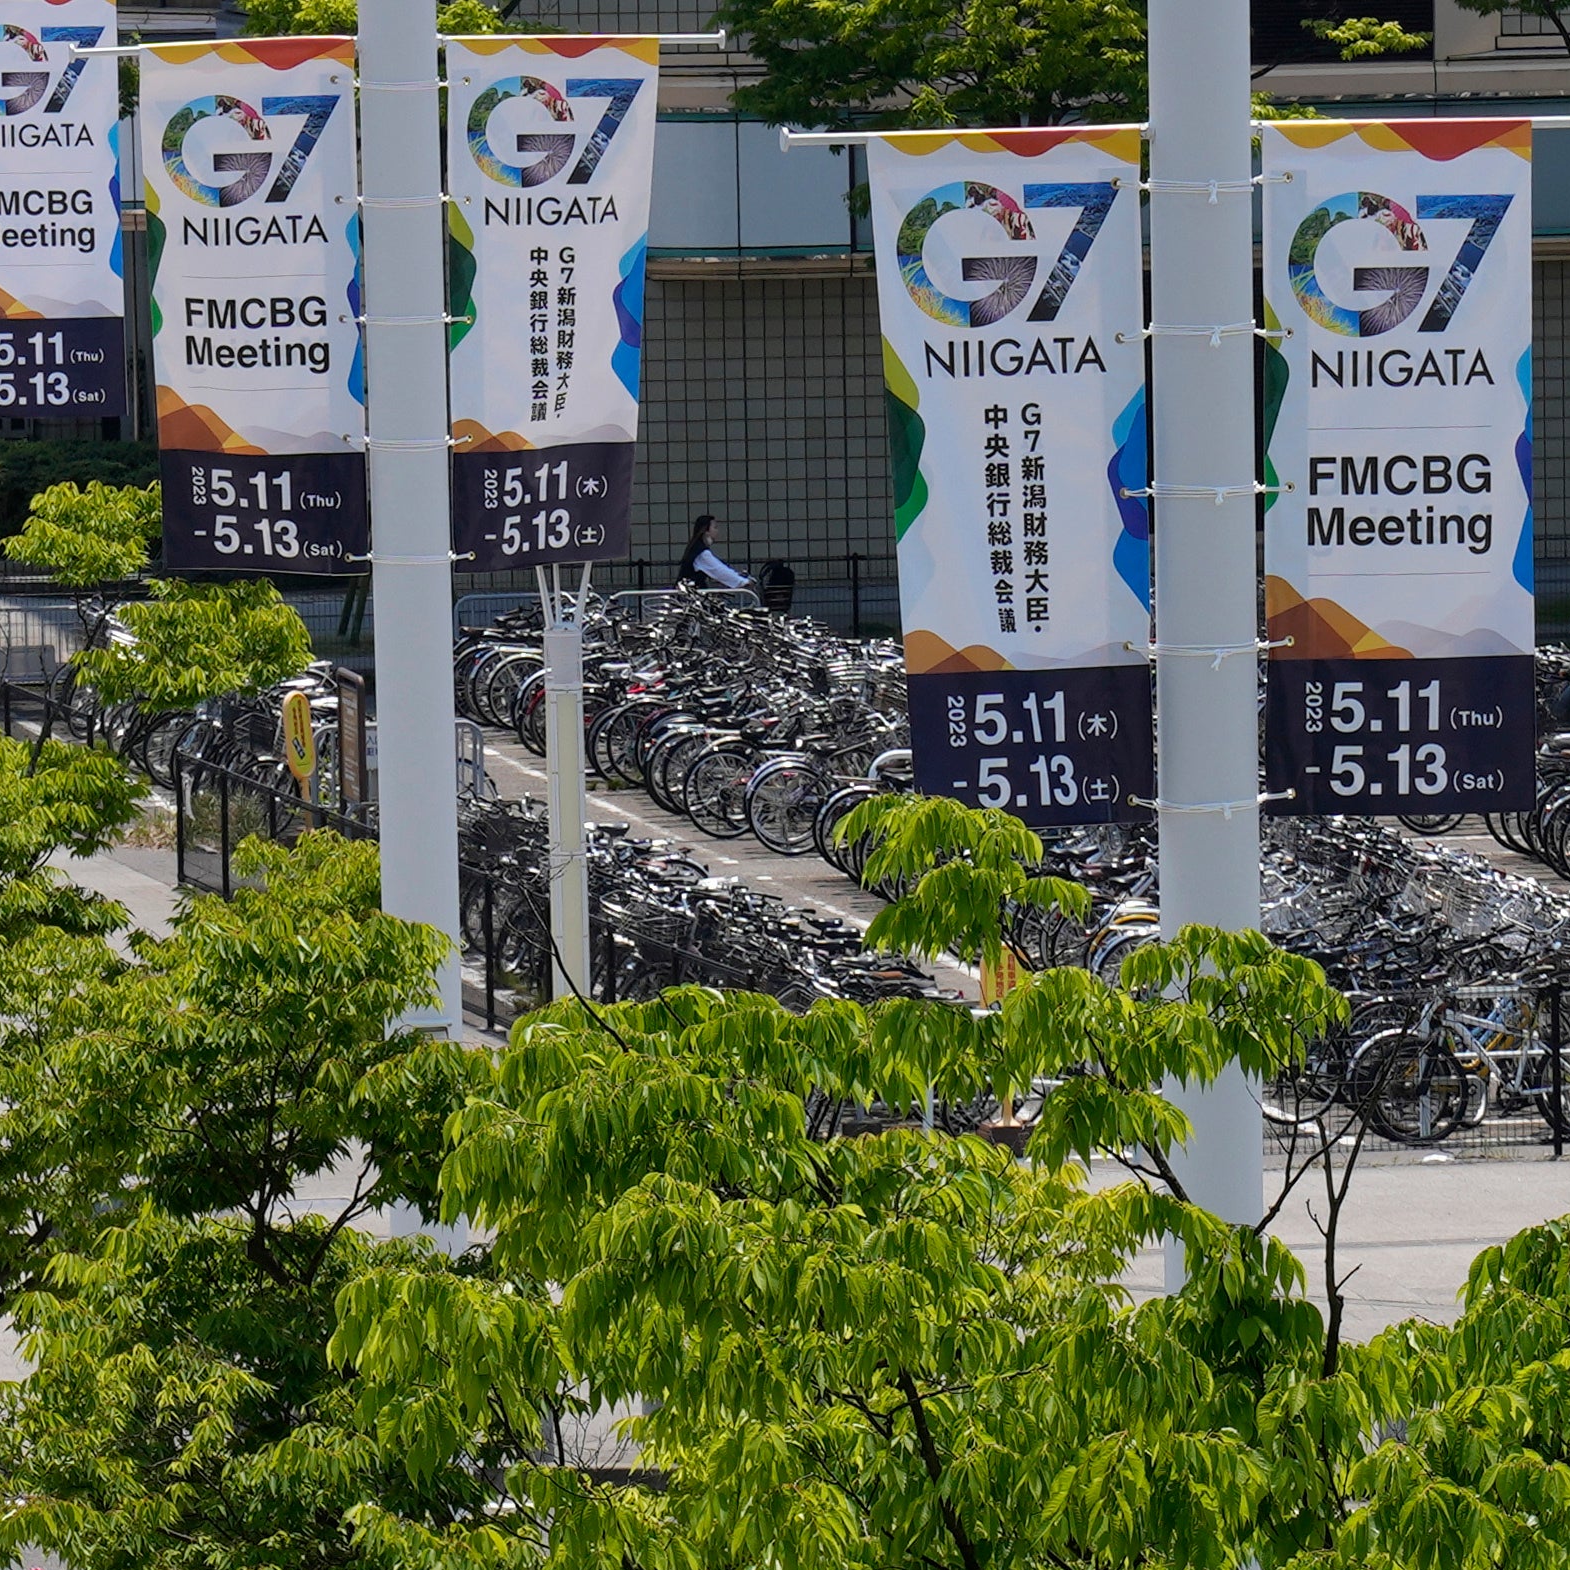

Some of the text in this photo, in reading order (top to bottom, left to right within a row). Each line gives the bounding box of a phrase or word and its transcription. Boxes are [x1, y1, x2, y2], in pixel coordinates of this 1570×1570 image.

[162, 94, 341, 207] G7
[467, 75, 645, 188] G7
[184, 215, 328, 246] NIIGATA
[485, 196, 618, 225] NIIGATA
[896, 181, 1120, 327] G7
[1288, 191, 1515, 337] G7
[185, 296, 326, 329] FMCBG
[530, 247, 549, 421] 中央銀行総裁会議
[186, 336, 329, 374] Meeting
[924, 336, 1106, 378] NIIGATA
[1312, 348, 1494, 388] NIIGATA
[192, 467, 206, 504] 2023
[212, 469, 291, 510] 5.11
[485, 470, 498, 508] 2023
[503, 461, 567, 507] 5.11
[1310, 454, 1491, 495] FMCBG
[485, 510, 570, 555] -5.13
[985, 405, 1016, 633] 中央銀行総裁会議
[1308, 506, 1492, 554] Meeting
[948, 696, 967, 747] 2023
[974, 691, 1065, 745] 5.11
[1306, 682, 1322, 732] 2023
[1331, 680, 1439, 732] 5.11
[953, 755, 1077, 808] -5.13
